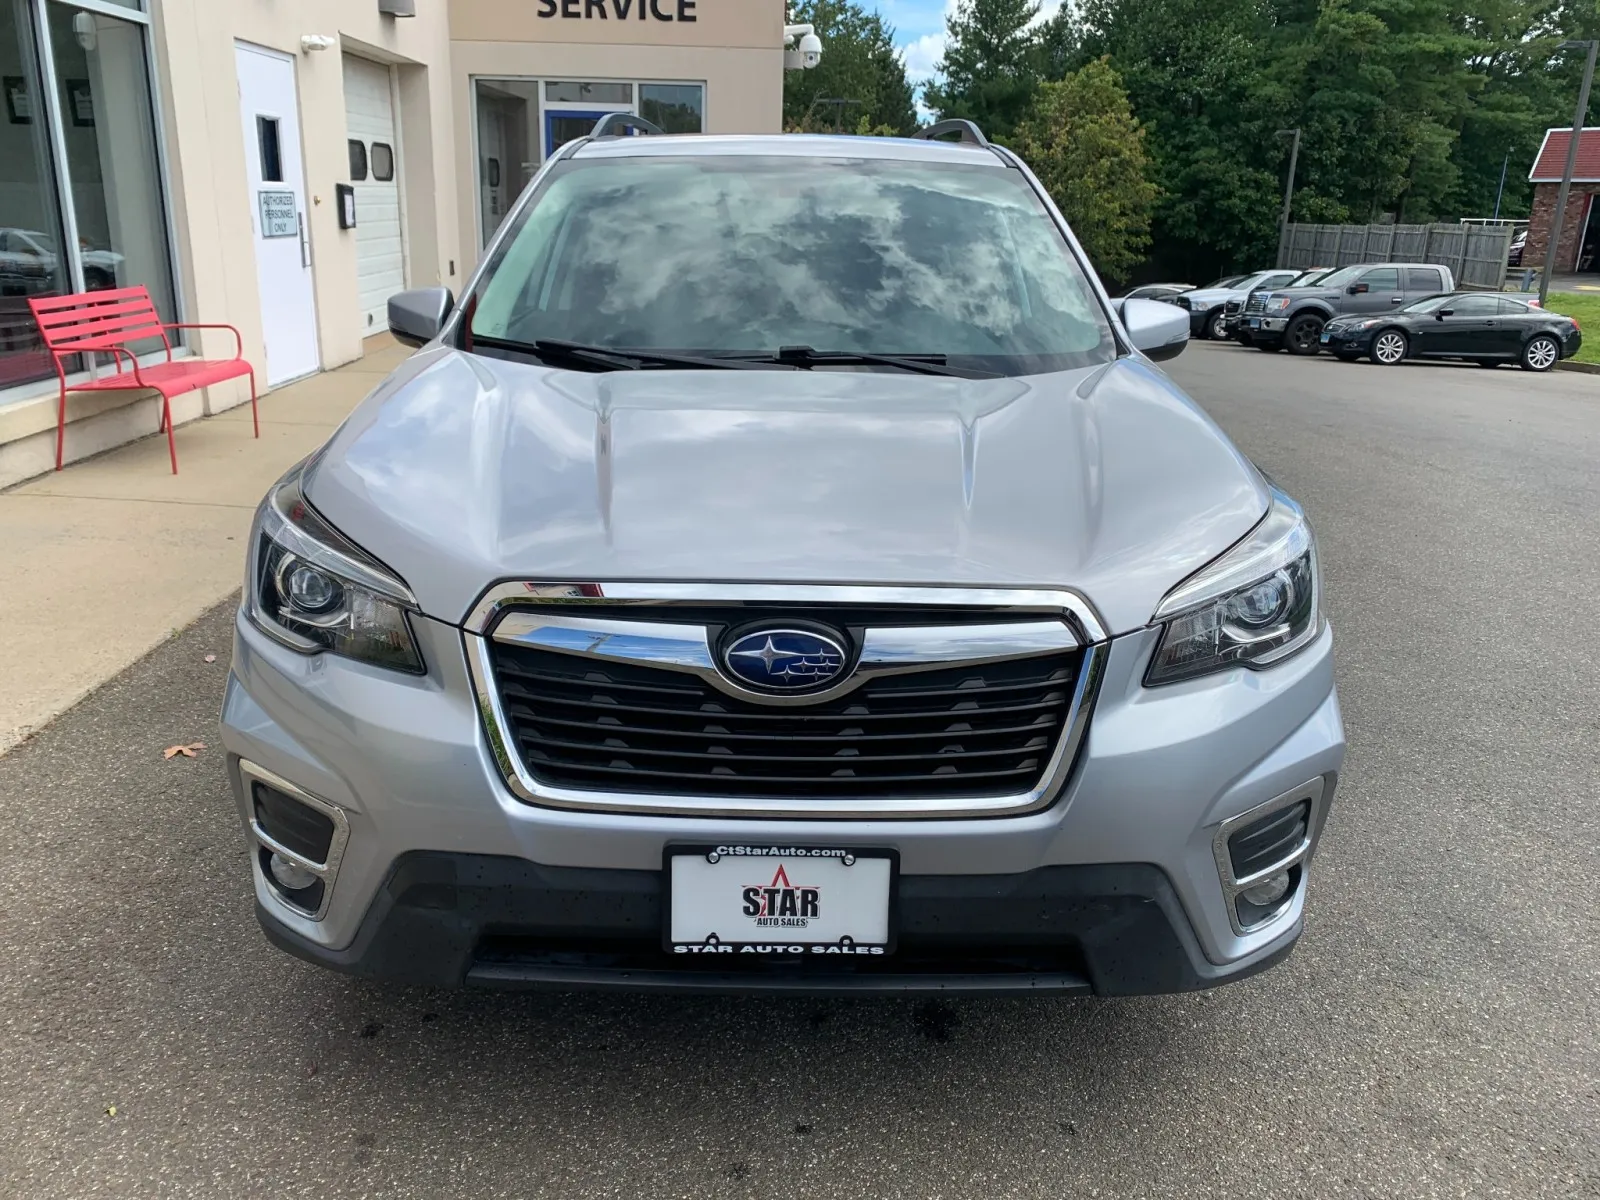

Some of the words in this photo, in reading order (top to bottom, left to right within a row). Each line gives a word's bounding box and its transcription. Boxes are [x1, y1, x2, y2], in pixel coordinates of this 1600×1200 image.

[537, 0, 697, 22] SERVICE
[263, 195, 293, 206] AUTHORIZED
[265, 209, 294, 220] PERSONNEL
[274, 223, 287, 233] ONLY
[716, 845, 846, 857] CtStarAuto.com
[742, 887, 820, 918] STAR
[756, 918, 779, 926] AUTO
[780, 918, 806, 927] SALES
[673, 945, 733, 954] STAR
[740, 945, 804, 954] AUTO
[811, 946, 885, 955] SALES
